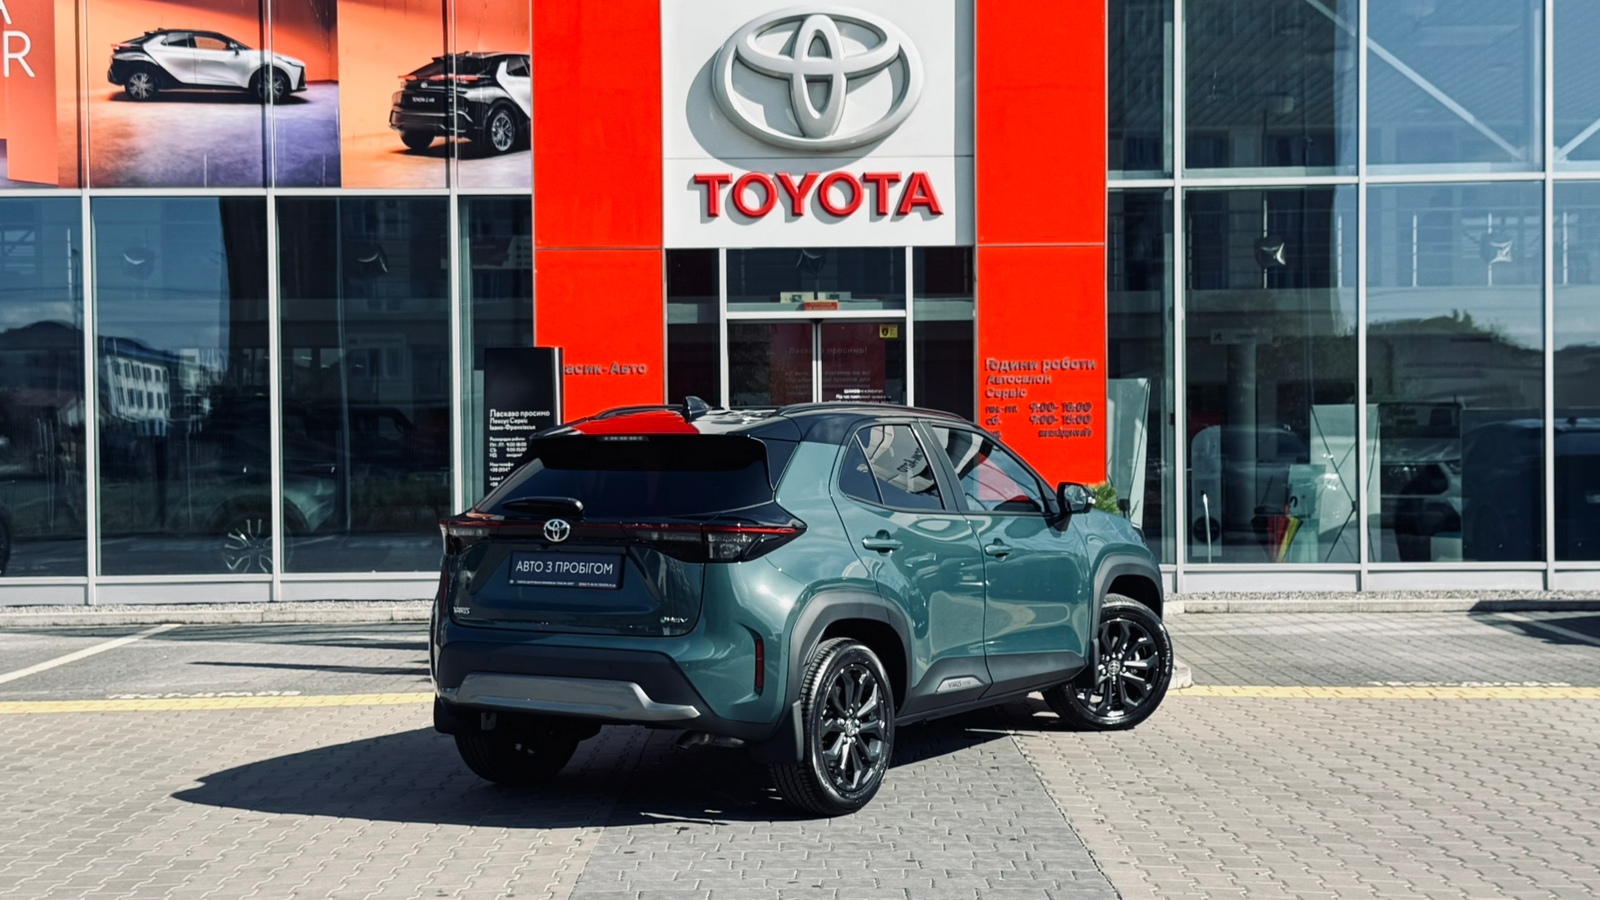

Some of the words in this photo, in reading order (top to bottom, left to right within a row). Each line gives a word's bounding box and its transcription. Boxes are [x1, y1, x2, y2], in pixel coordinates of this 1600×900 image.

[694, 171, 944, 218] TOYOTA
[985, 358, 1039, 373] Години
[1042, 357, 1097, 373] роботи
[986, 374, 1052, 385] Автосалон
[985, 387, 1028, 401] Сервіс
[490, 408, 519, 418] Ласкаво
[520, 410, 550, 419] просимо
[516, 561, 543, 573] АВТО
[555, 562, 613, 575] ПРОБІГОМ
